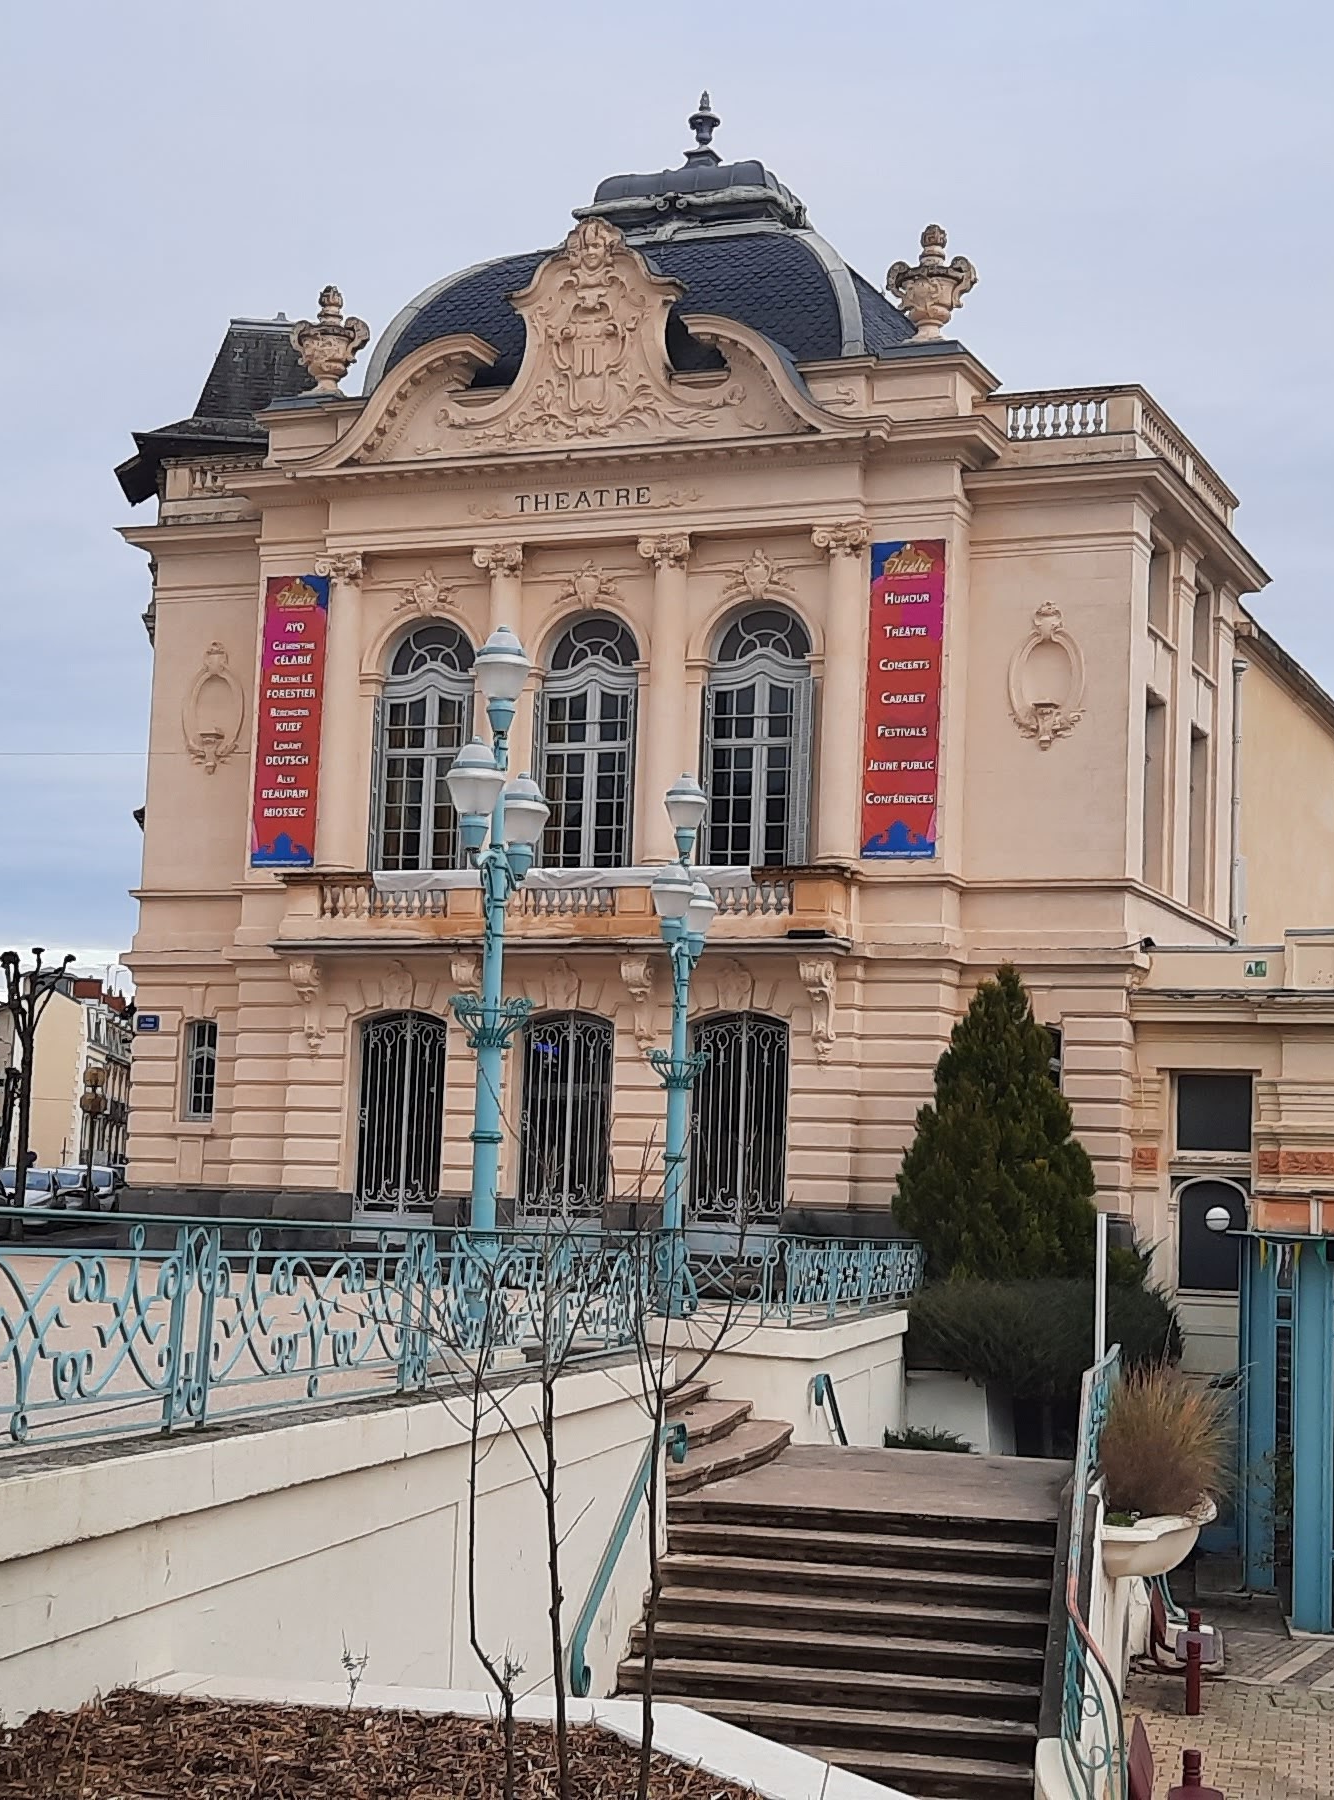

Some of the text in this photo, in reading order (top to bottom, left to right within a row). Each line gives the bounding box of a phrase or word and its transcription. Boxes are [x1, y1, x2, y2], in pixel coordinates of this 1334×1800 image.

[515, 487, 651, 512] THEATRE
[884, 592, 930, 604] HUMOUR
[879, 658, 930, 671] CONCERTS
[301, 674, 314, 683] LE
[266, 688, 316, 699] FORESTIER
[881, 692, 926, 704] CABARET
[877, 725, 928, 738] FESTIVALS
[266, 755, 309, 765] DEUTSCH
[867, 760, 935, 771] JEUNE PUBLIC
